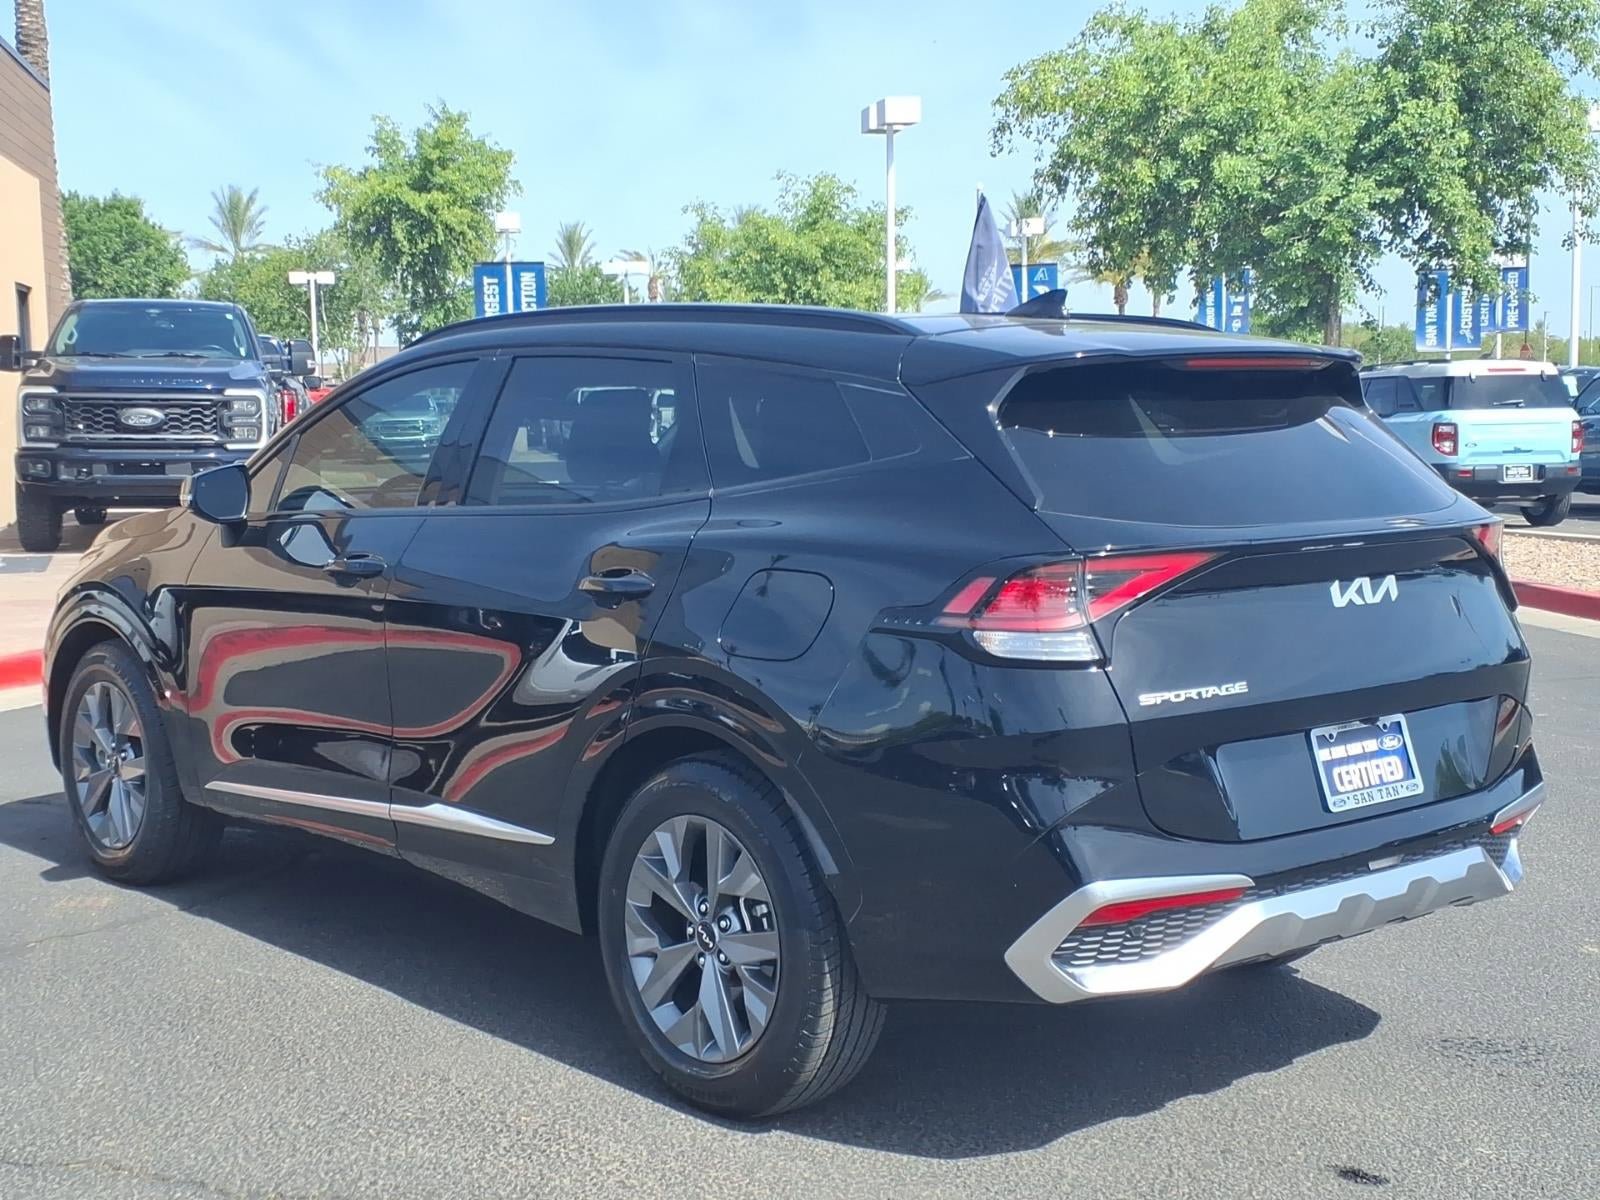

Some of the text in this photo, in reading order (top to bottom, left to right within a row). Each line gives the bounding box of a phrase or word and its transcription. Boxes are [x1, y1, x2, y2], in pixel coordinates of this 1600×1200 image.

[482, 276, 500, 317] GEST
[1425, 325, 1437, 346] SAN
[1329, 574, 1399, 608] KIA
[1138, 680, 1249, 706] SPORTAGE
